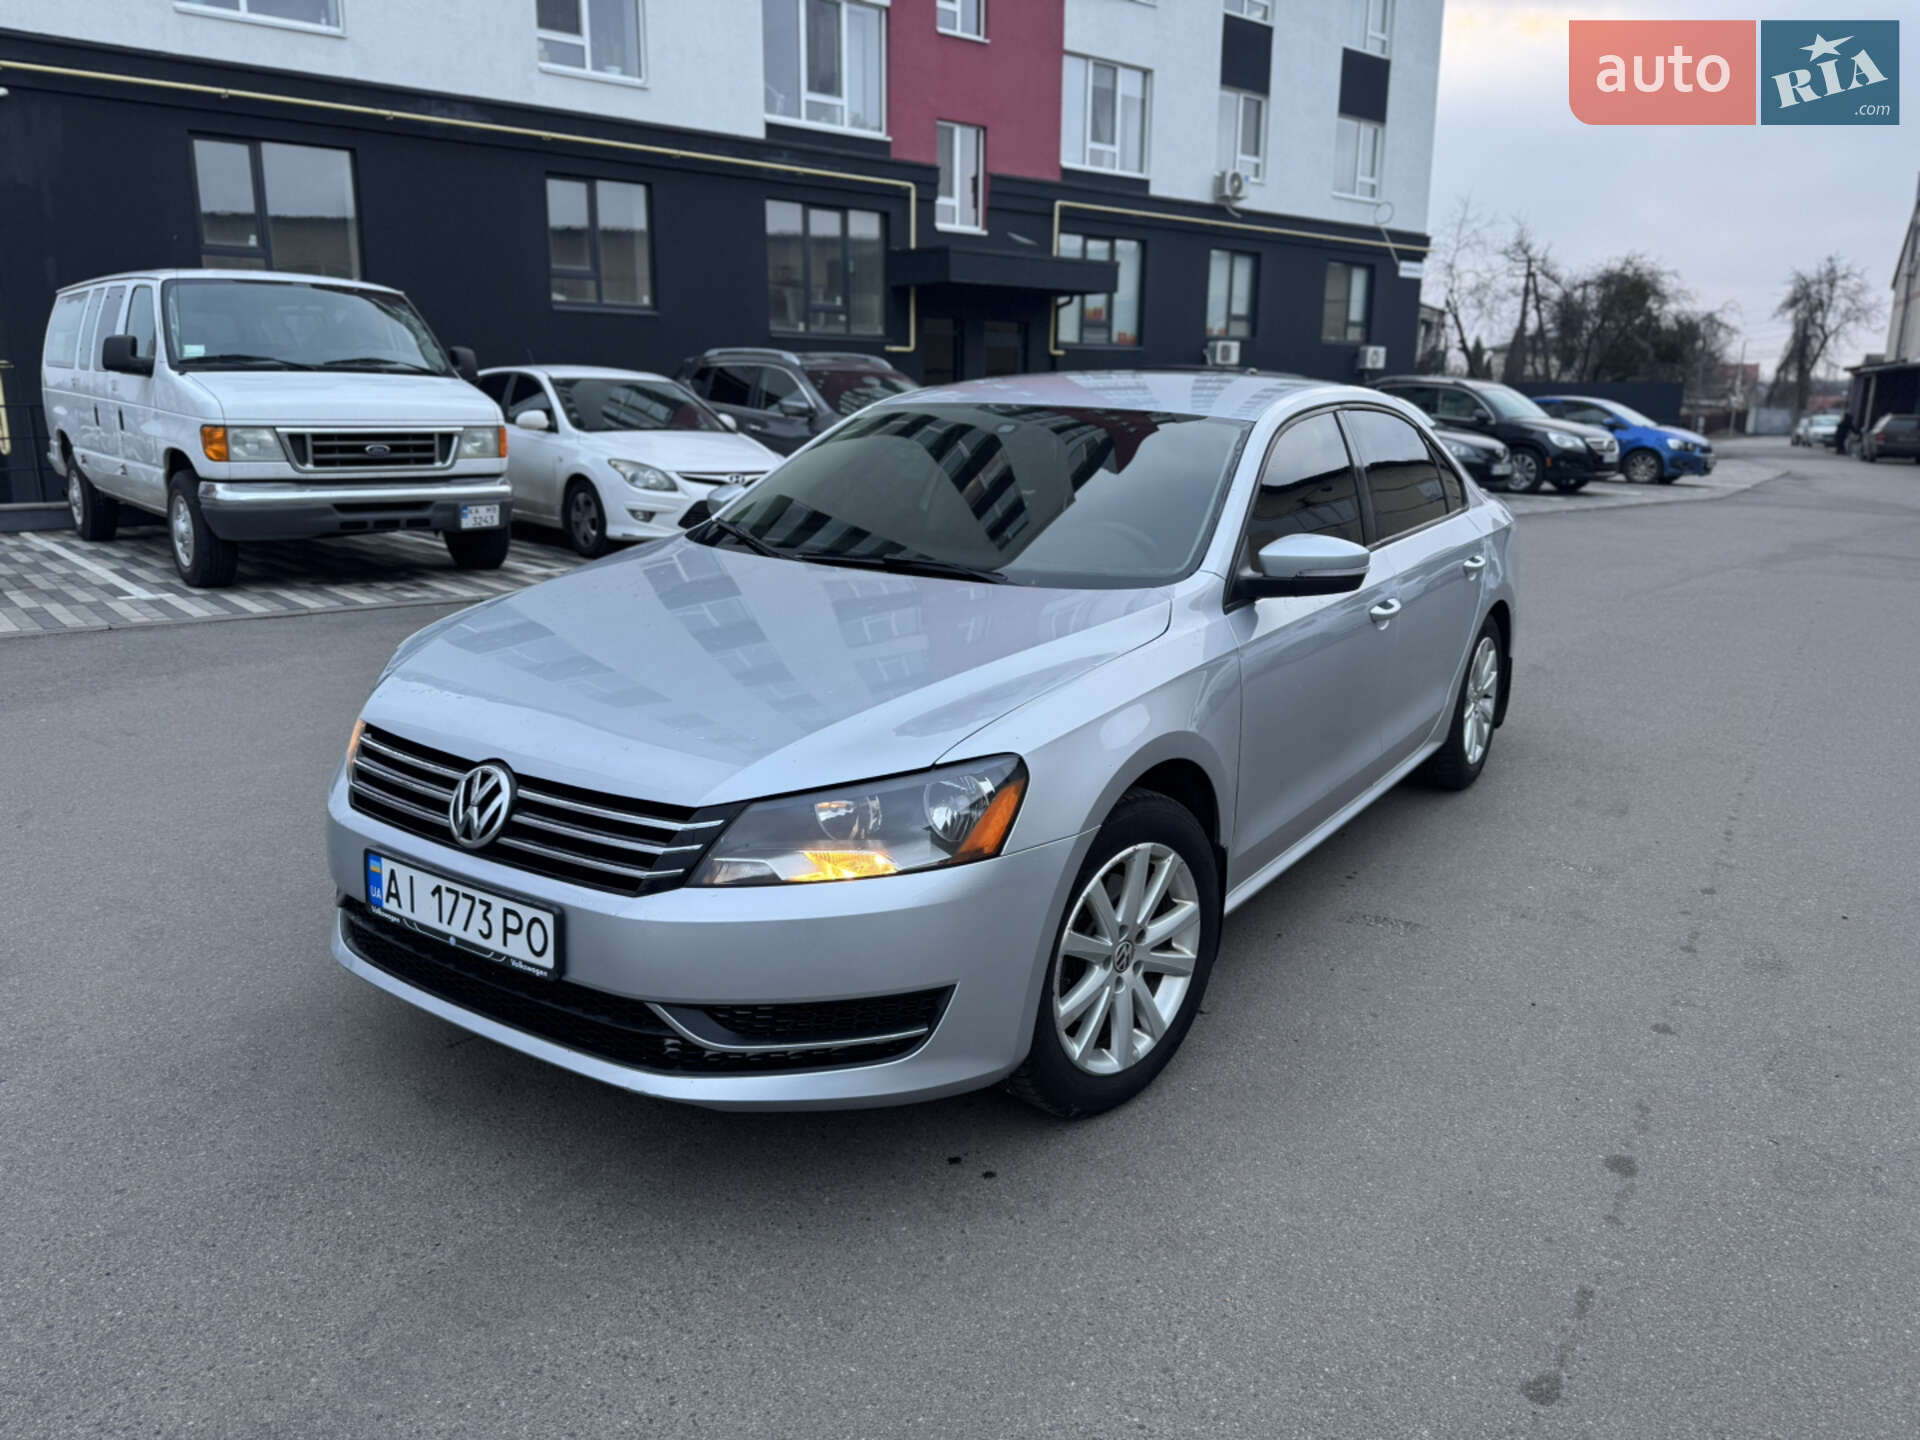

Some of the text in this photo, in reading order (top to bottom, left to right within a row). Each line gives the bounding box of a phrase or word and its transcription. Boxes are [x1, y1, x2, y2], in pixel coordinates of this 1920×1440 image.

[370, 885, 382, 899] UA
[385, 868, 549, 958] AI 1773 PO
